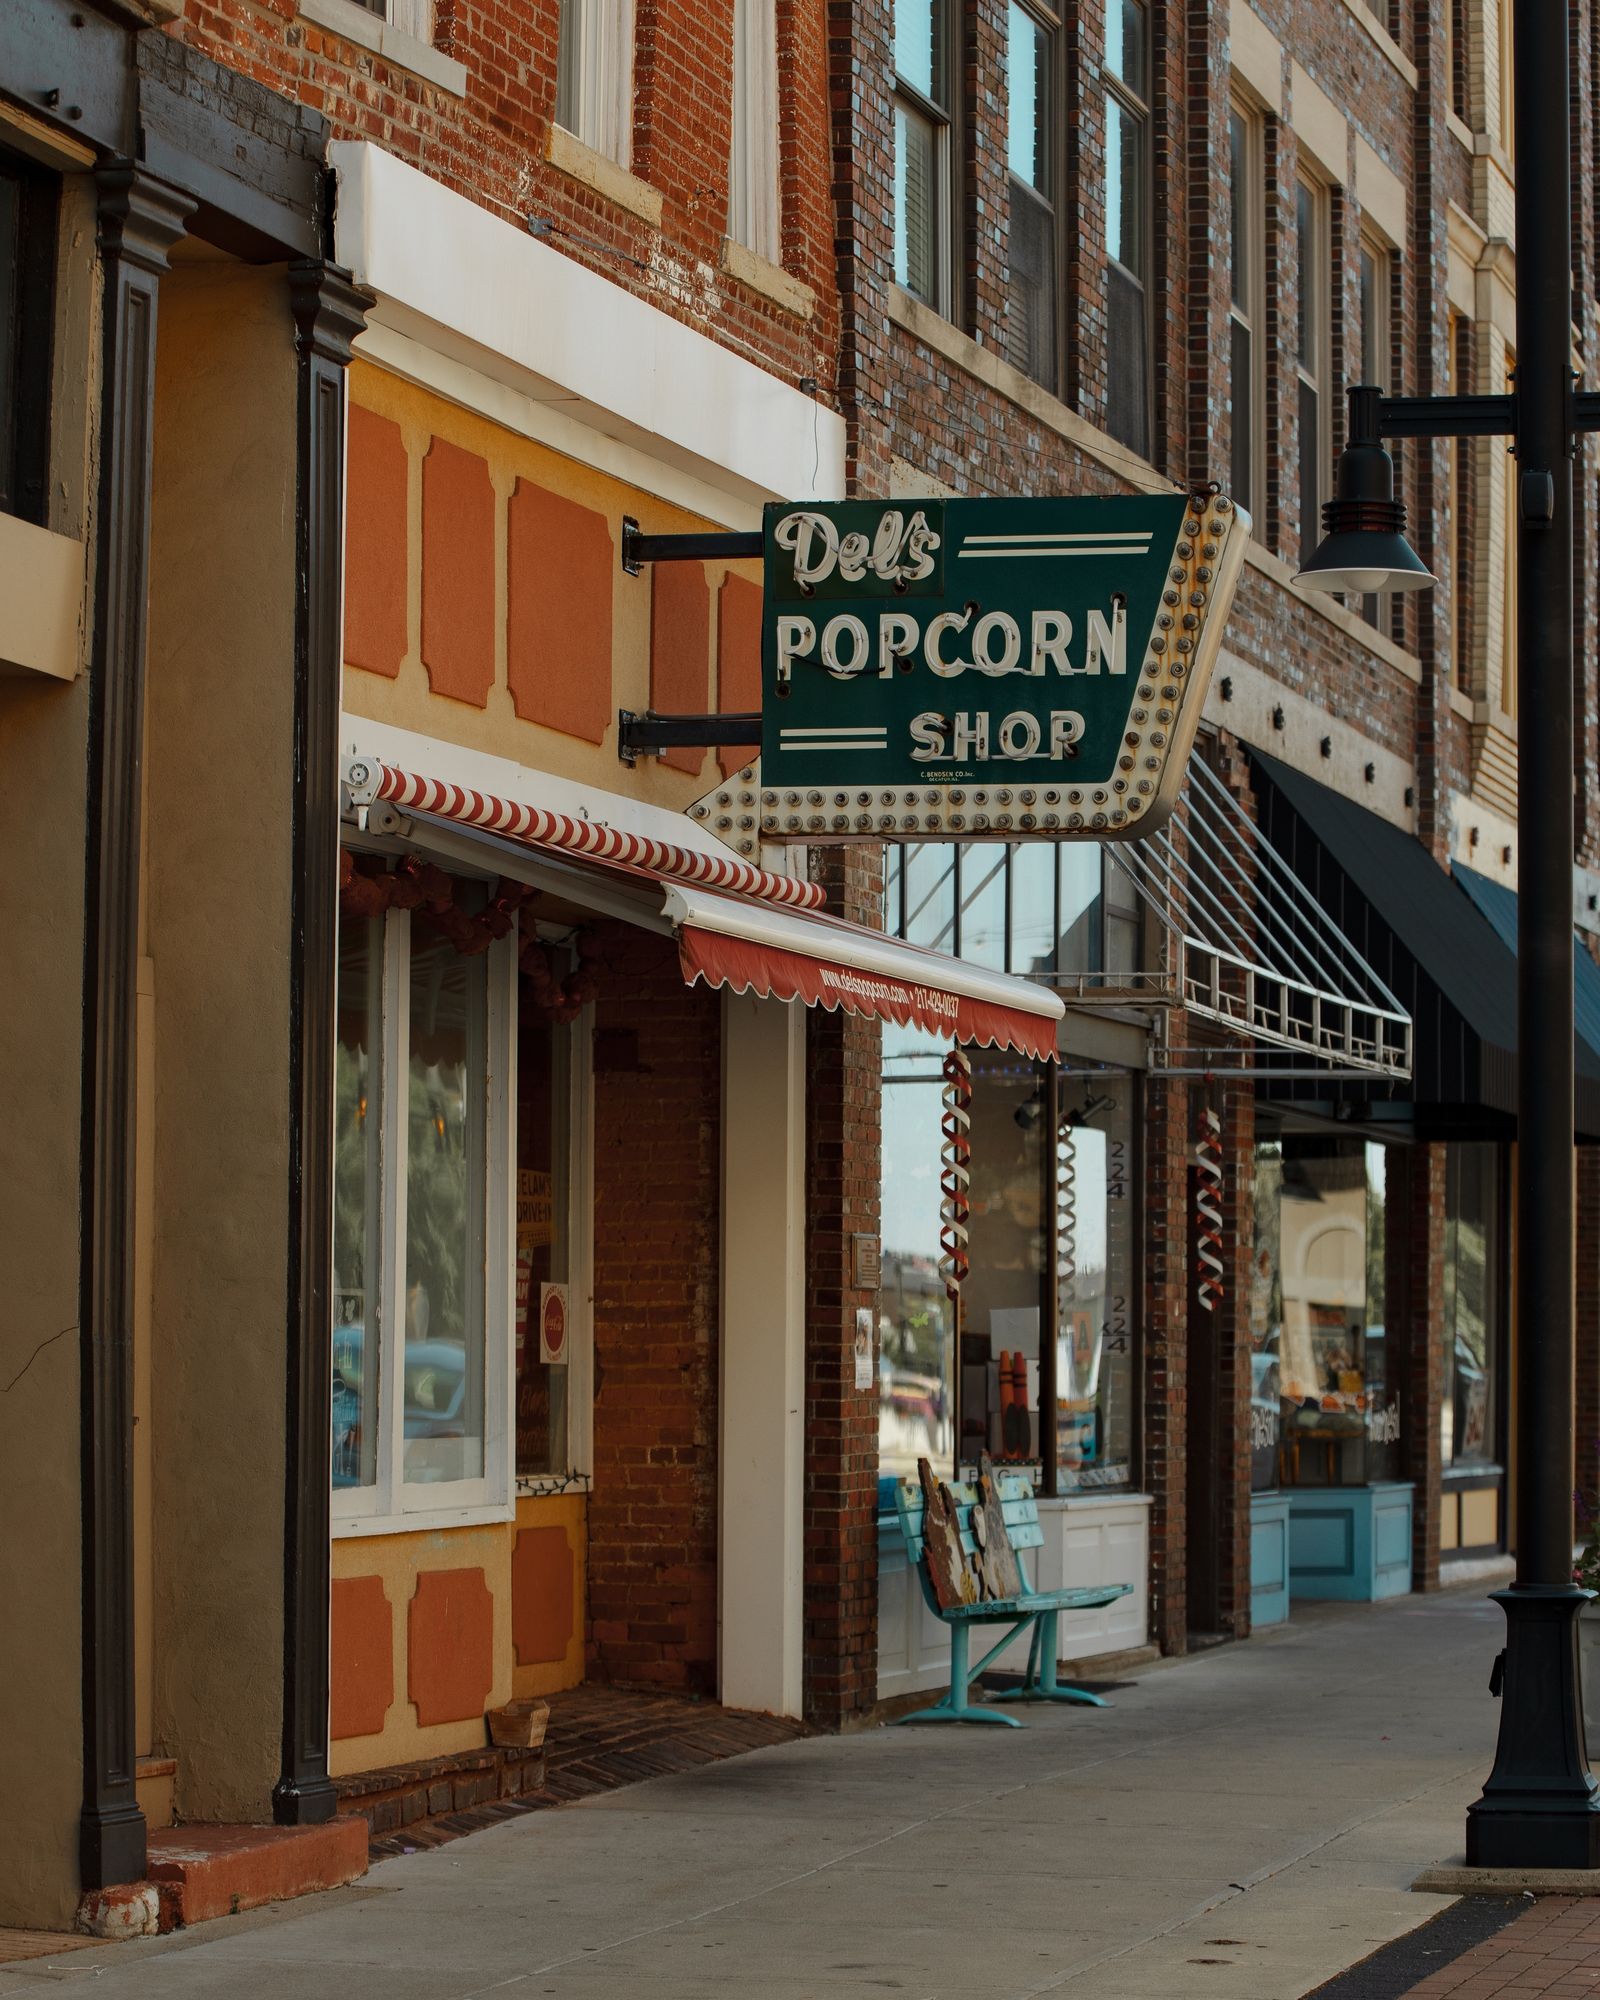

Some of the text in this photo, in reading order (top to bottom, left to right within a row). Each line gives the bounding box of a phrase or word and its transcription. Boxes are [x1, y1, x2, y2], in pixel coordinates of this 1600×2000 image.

[774, 510, 941, 583] Del's
[776, 608, 1127, 681] POPCORN
[909, 710, 1086, 763] SHOP
[819, 968, 910, 1004] www.delspopcorn.com
